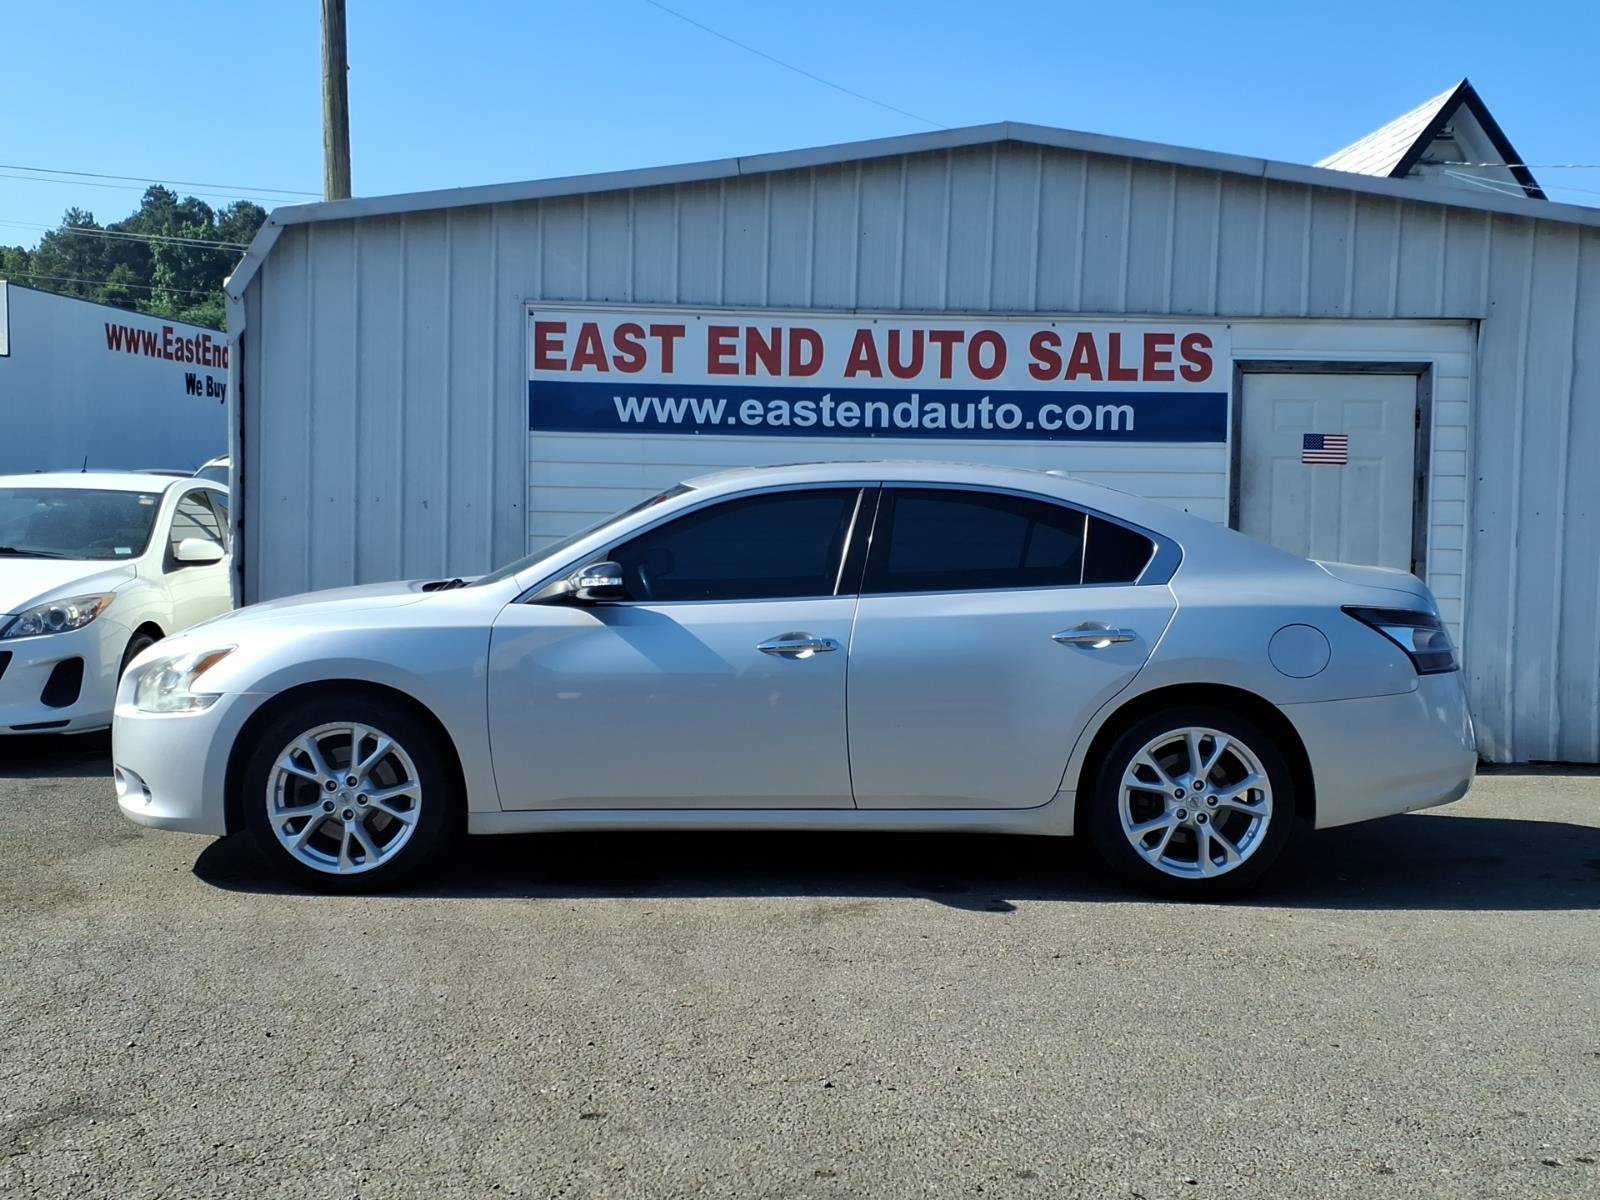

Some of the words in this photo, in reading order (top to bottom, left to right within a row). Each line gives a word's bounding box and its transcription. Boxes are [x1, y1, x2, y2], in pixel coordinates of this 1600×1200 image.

[534, 321, 686, 374] EAST
[707, 325, 824, 377] END
[843, 328, 1008, 381] AUTO
[1028, 330, 1213, 382] SALES
[185, 372, 203, 397] We
[206, 375, 227, 405] Buy
[613, 393, 1135, 431] www.eastendauto.com
